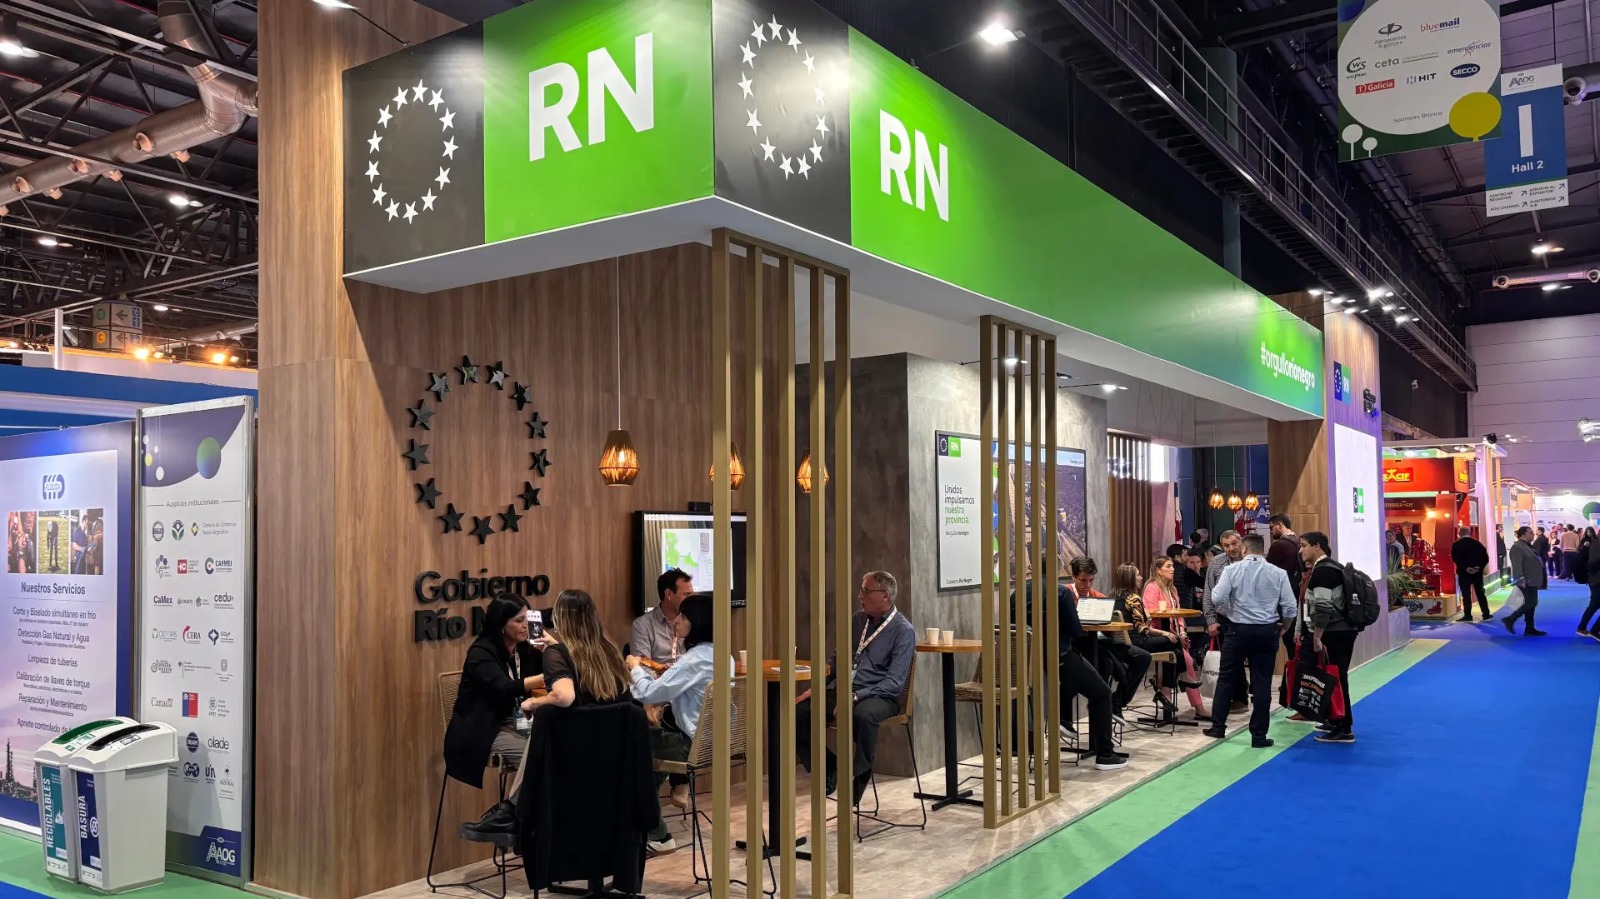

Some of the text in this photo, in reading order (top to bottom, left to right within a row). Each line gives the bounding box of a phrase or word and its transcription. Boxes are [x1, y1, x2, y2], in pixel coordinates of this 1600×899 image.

[1420, 17, 1460, 32] bluemail
[1418, 73, 1437, 82] HIT
[1451, 65, 1478, 76] SECCO
[1367, 80, 1393, 91] Galicia
[528, 31, 655, 163] RN
[879, 108, 949, 222] RN
[1511, 160, 1544, 173] Hall 2
[944, 484, 963, 495] Unidos
[21, 581, 86, 595] Nuestros Servicios
[414, 567, 551, 604] Gobierno
[12, 606, 26, 616] Corte
[30, 607, 51, 617] Biselado
[79, 611, 87, 619] en
[415, 606, 467, 643] Río
[42, 629, 53, 639] Gas
[53, 630, 71, 641] Natural
[76, 632, 90, 644] Agua
[27, 653, 49, 665] Limpieza
[50, 656, 57, 665] de
[43, 674, 50, 684] de
[65, 676, 73, 687] de
[50, 697, 88, 712] Mantenimiento
[43, 777, 53, 849] RECICLABLES
[78, 795, 88, 839] BASURA
